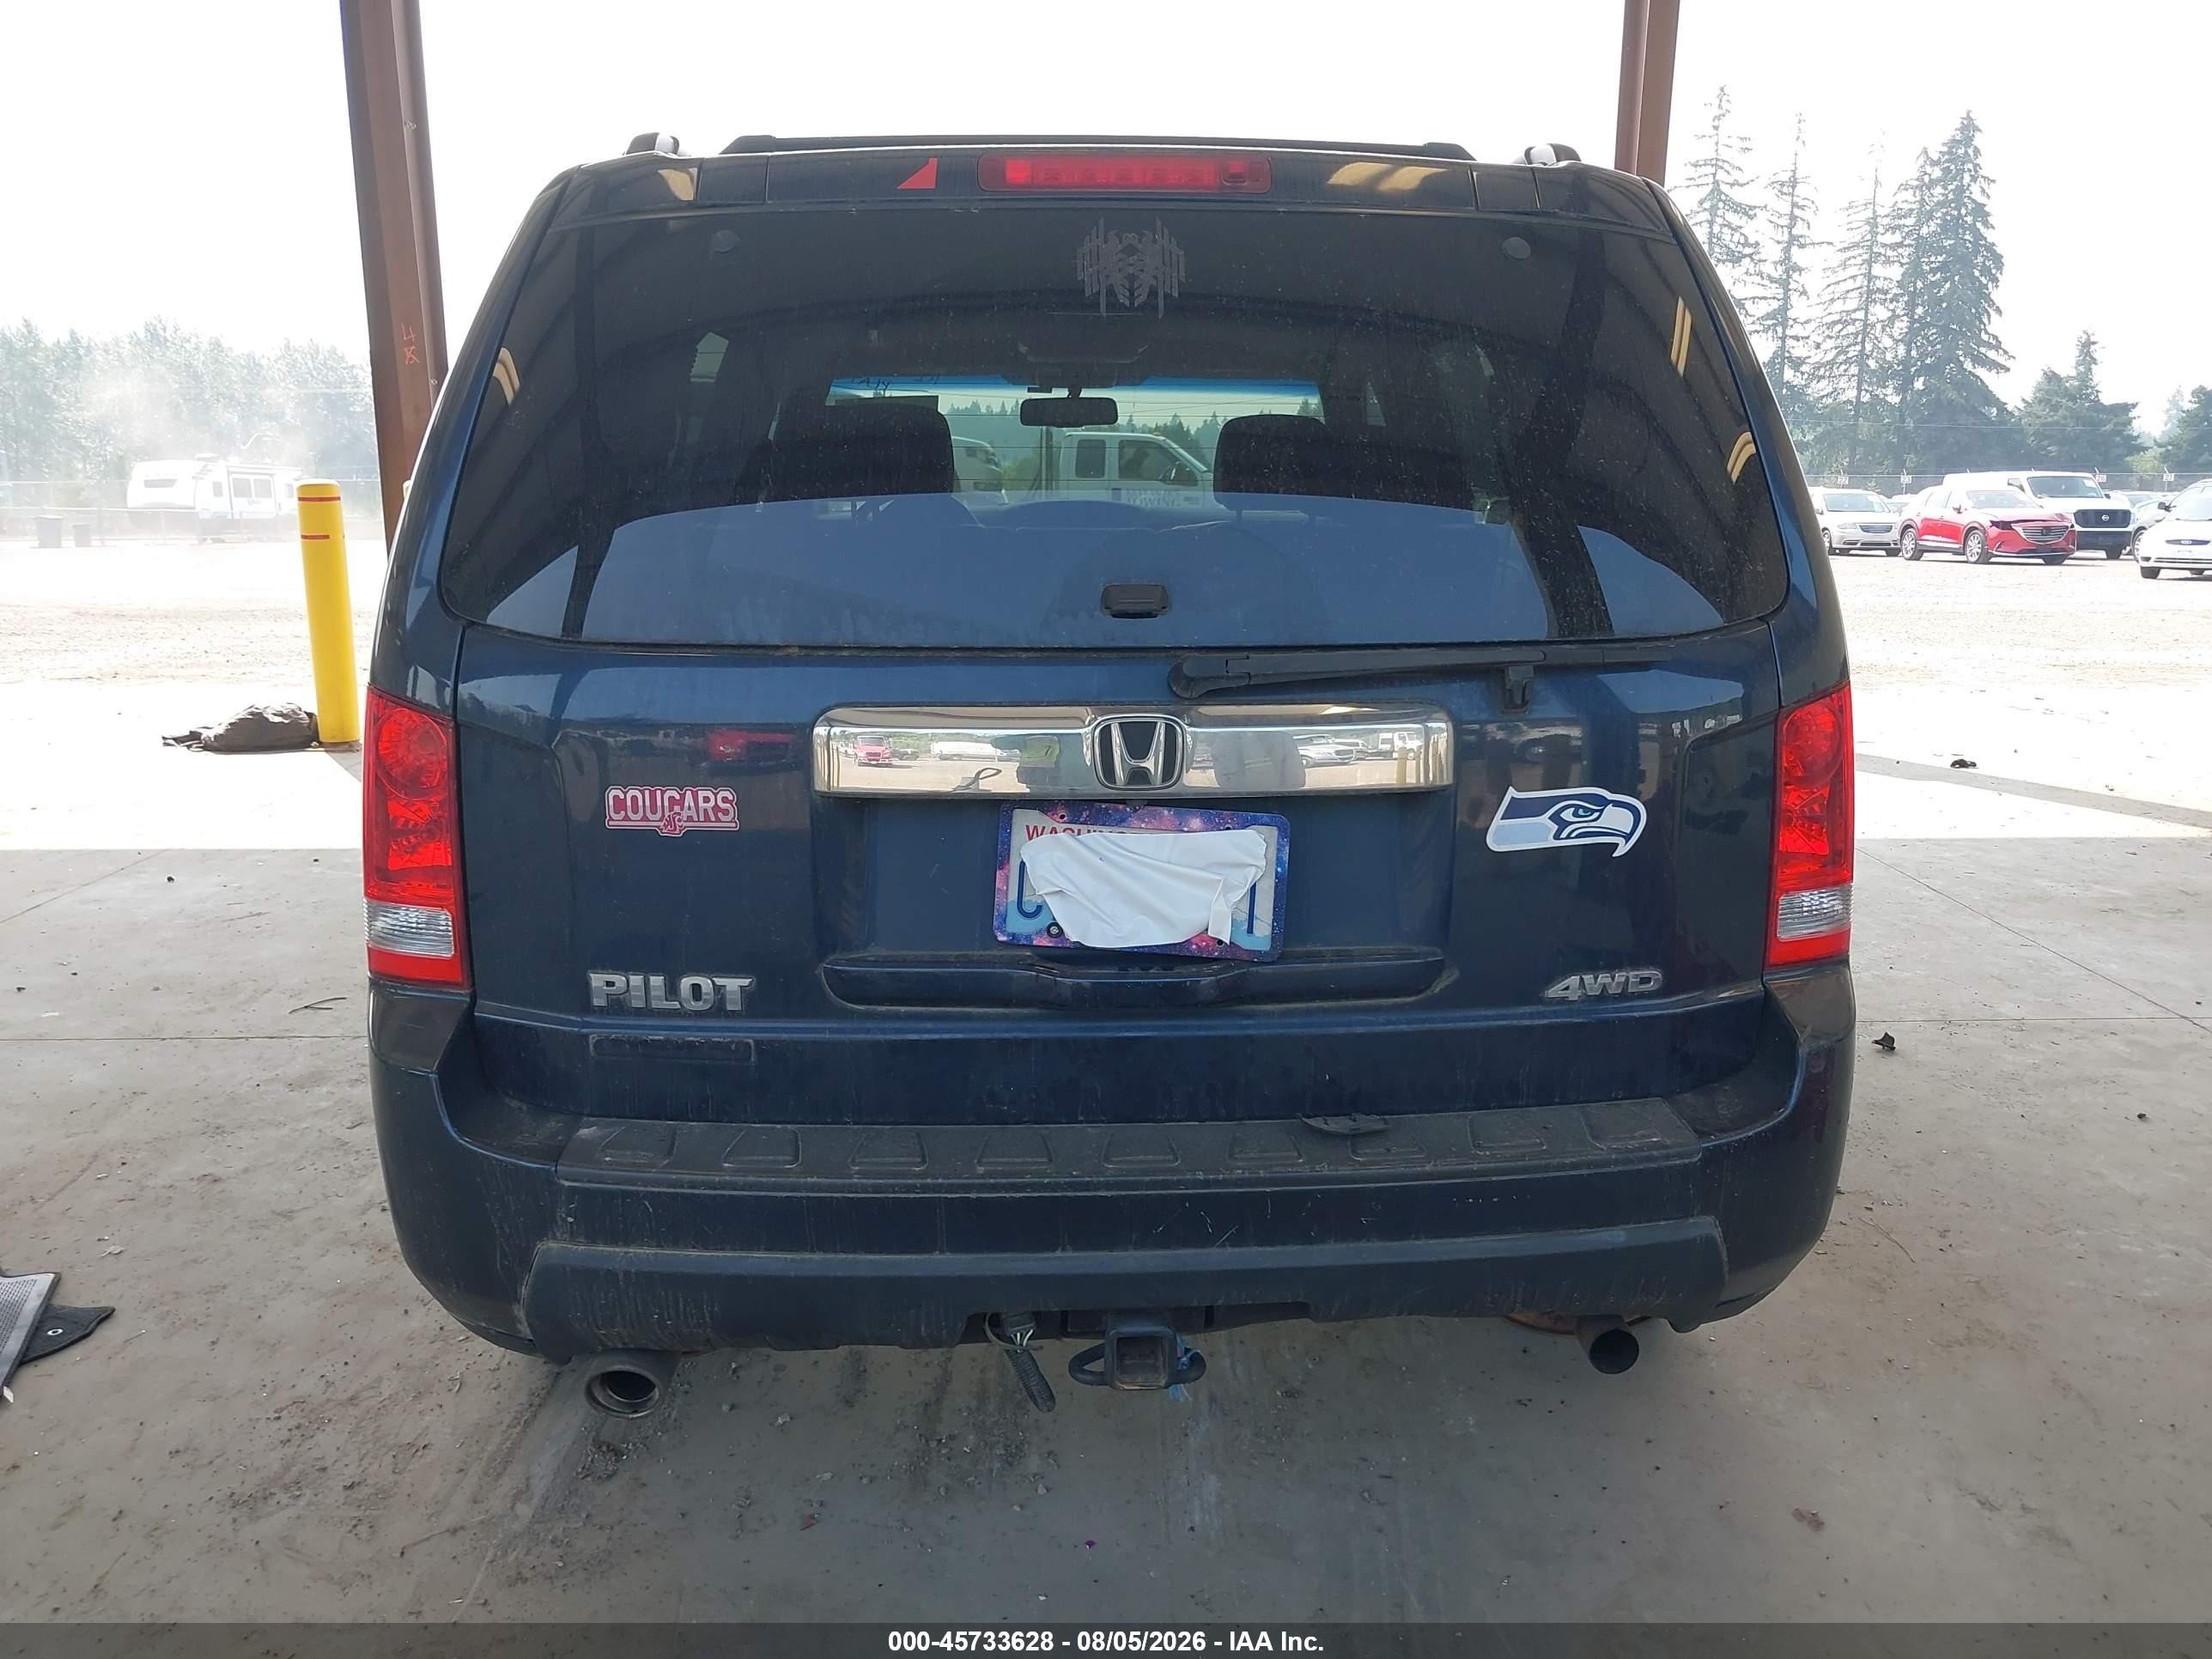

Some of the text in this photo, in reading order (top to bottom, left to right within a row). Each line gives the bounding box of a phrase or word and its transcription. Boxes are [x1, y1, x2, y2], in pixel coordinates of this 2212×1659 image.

[607, 788, 737, 822] COUGARS
[589, 972, 754, 1012] PILOT
[1545, 970, 1662, 1001] 4WD
